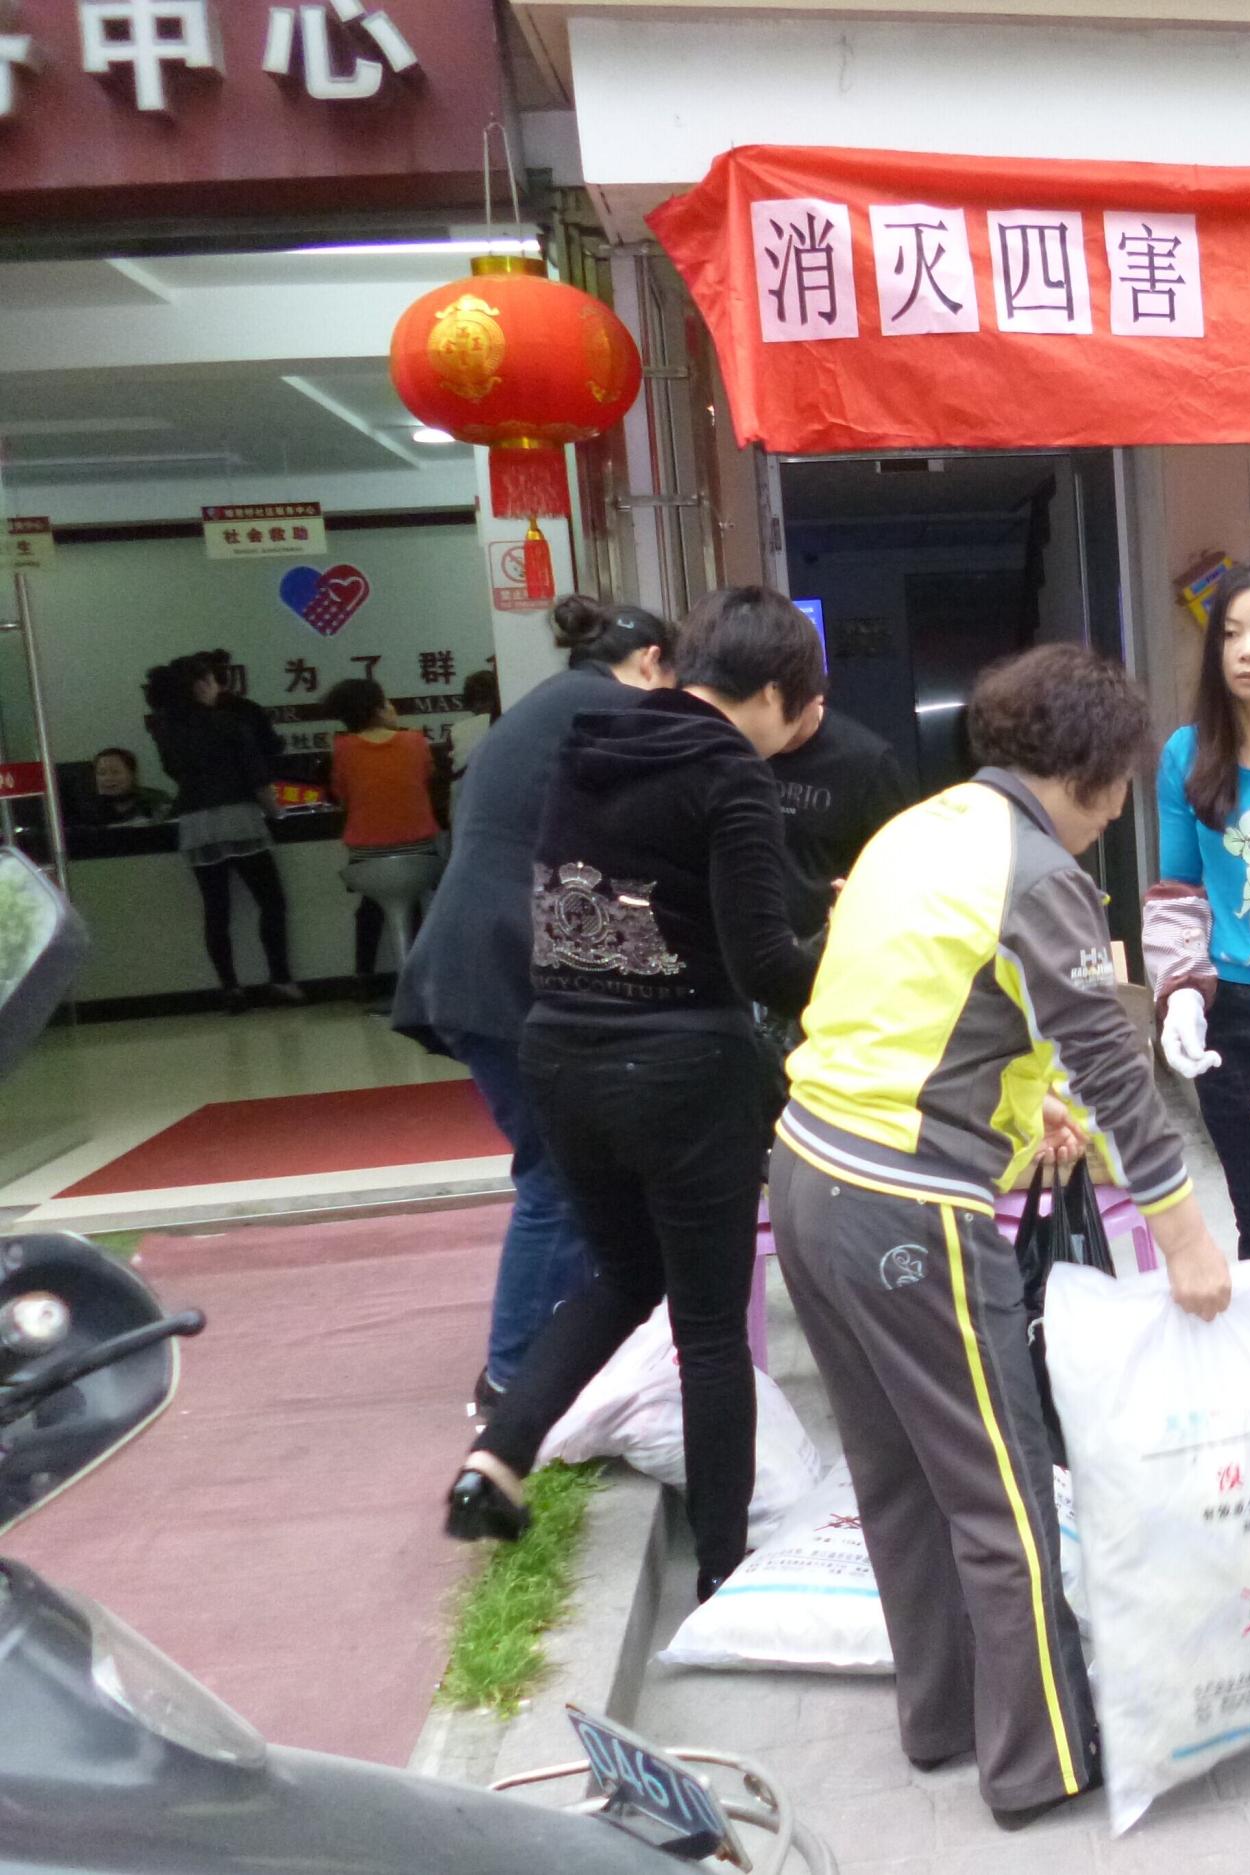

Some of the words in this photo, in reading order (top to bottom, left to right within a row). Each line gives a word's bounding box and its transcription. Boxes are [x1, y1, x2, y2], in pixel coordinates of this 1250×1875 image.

[0, 0, 417, 114] 中心
[765, 213, 1186, 325] 消灭四害
[223, 526, 308, 545] 社会救助
